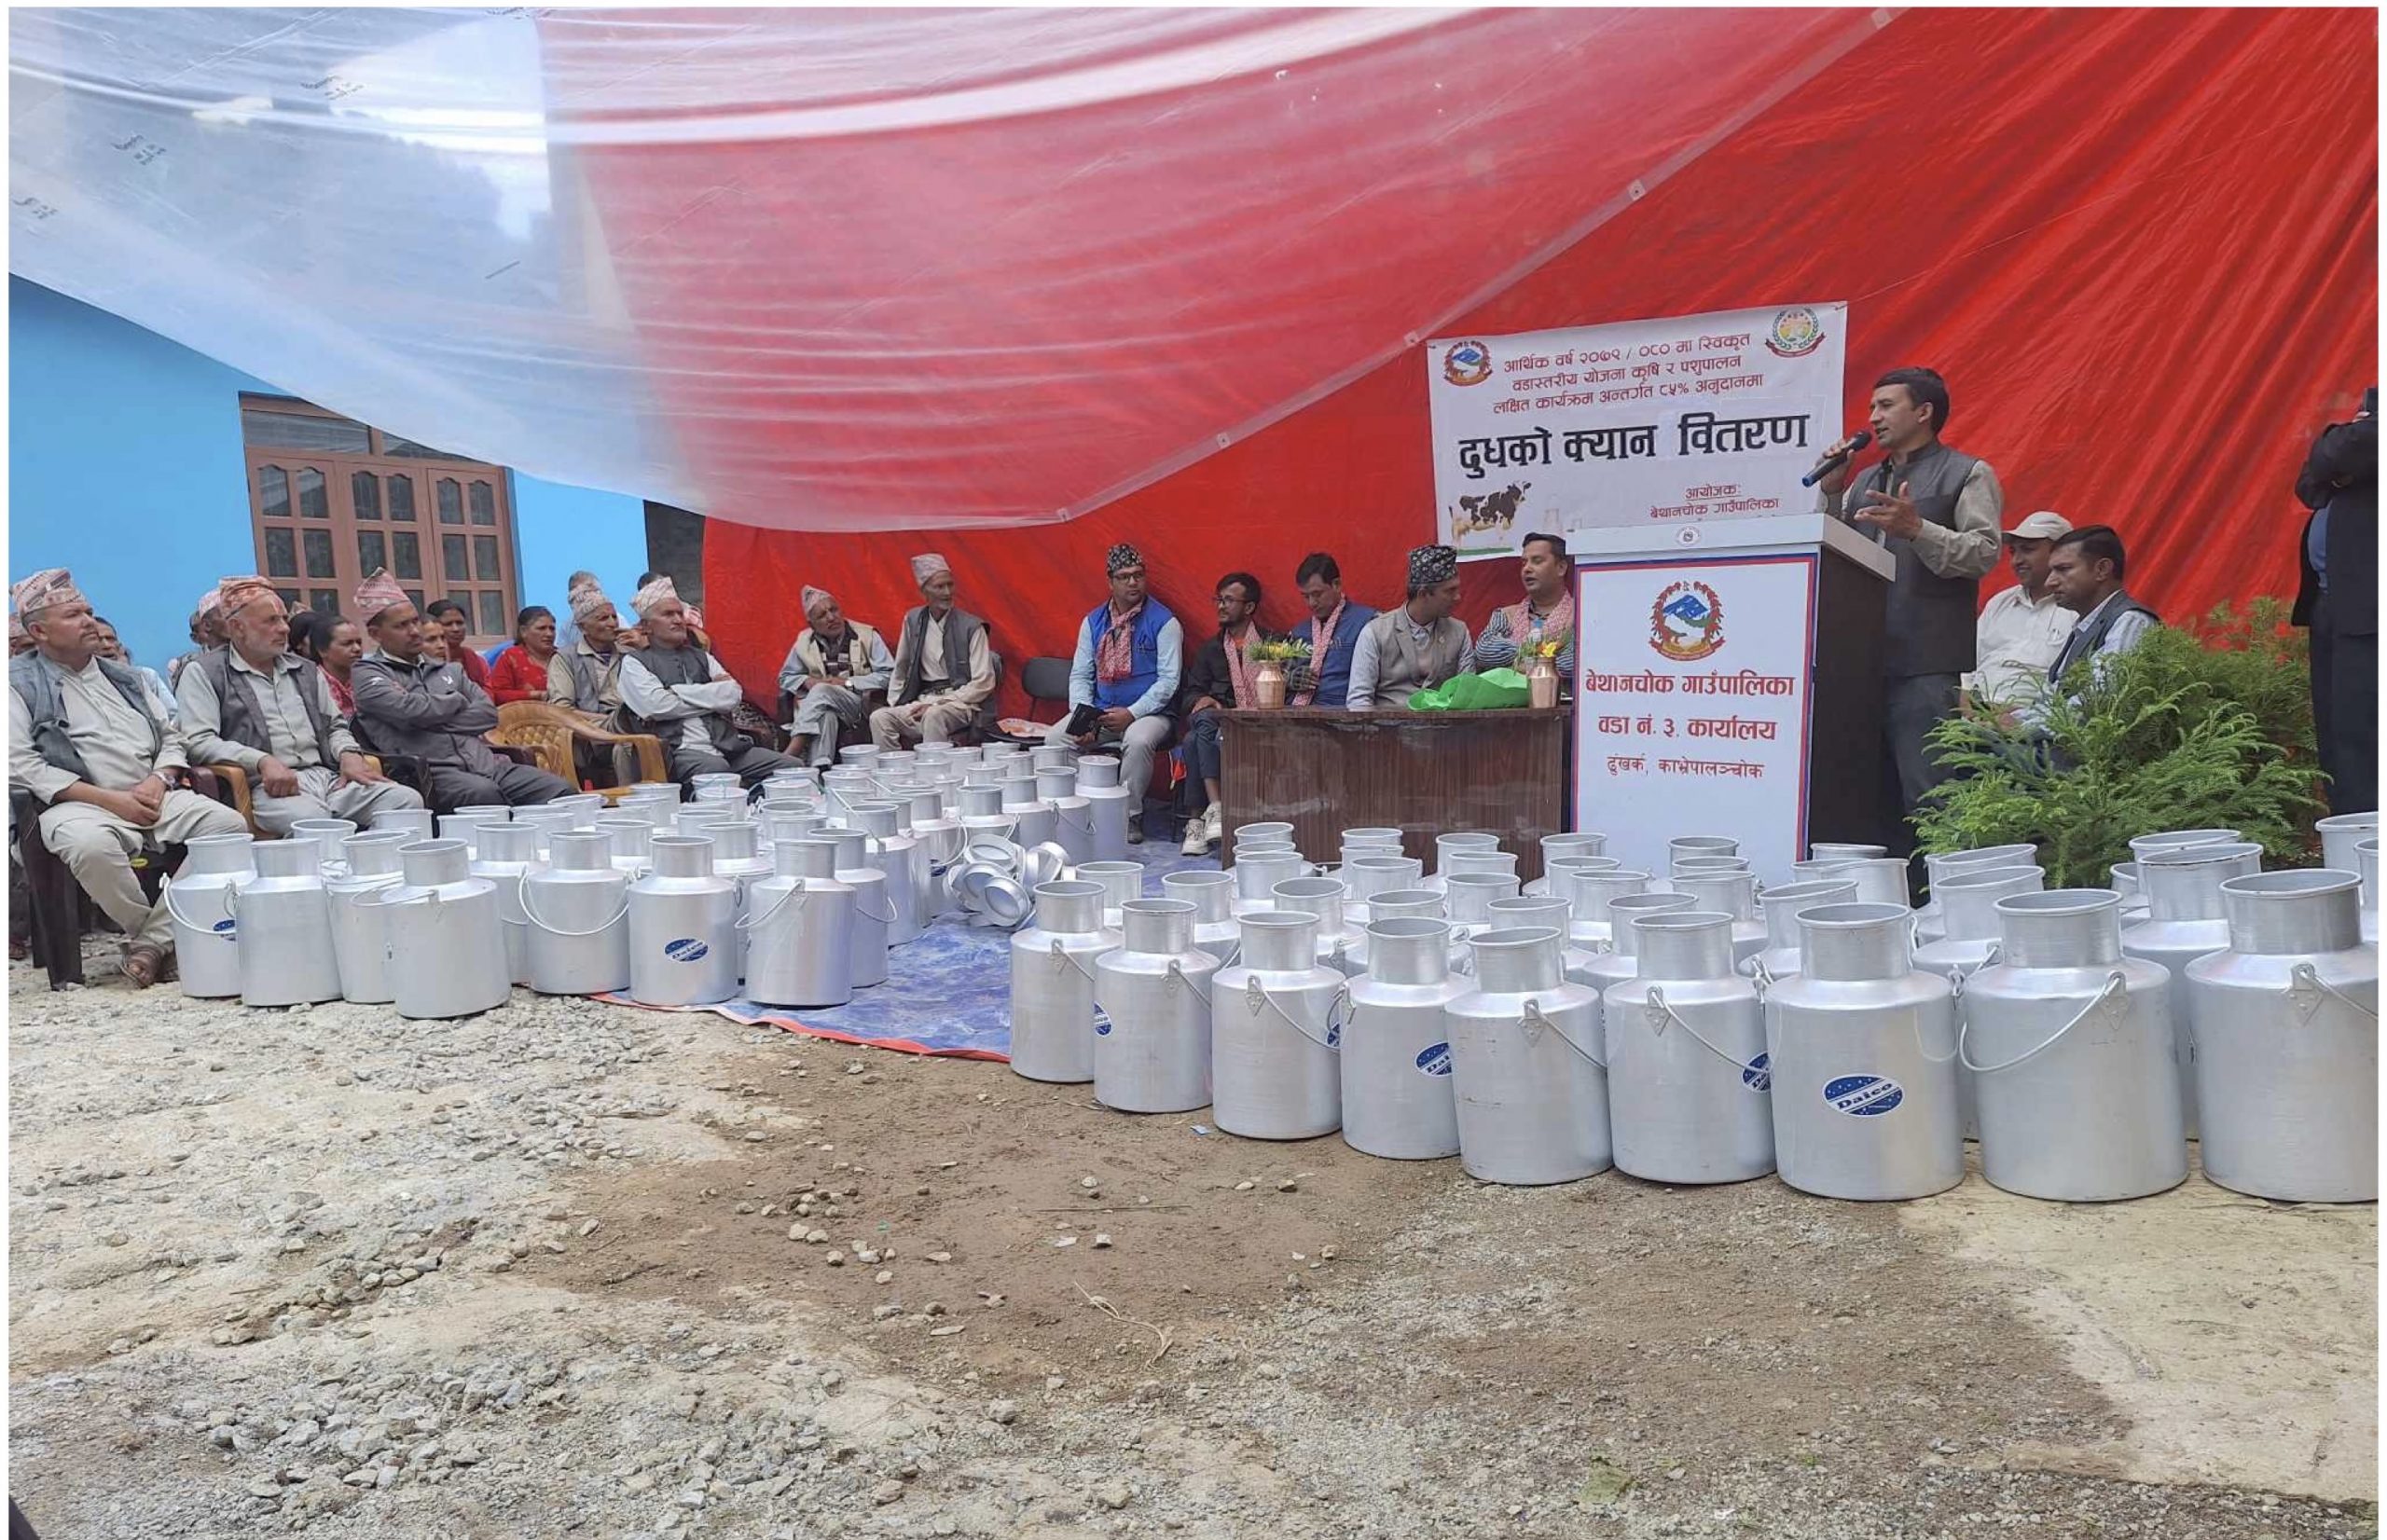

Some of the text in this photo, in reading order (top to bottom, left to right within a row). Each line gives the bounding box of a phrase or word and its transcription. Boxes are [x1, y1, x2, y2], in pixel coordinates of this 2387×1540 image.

[1504, 353, 1549, 373] आर्थिक
[1555, 349, 1573, 366] वर्ष
[1676, 339, 1692, 354] मा
[1512, 372, 1578, 392] वडास्तरीय
[1583, 366, 1625, 385] योजना
[1631, 362, 1660, 384] कृषि
[1666, 361, 1675, 375] र
[1680, 354, 1742, 376] पशुपालन
[1494, 398, 1530, 415] लक्षित
[1536, 390, 1594, 409] कार्यक्रम
[1599, 384, 1653, 404] अन्तर्गत
[1695, 373, 1763, 394] अनुदानमा
[1459, 413, 1810, 479] दुधको क्यान वितरण
[1650, 498, 1780, 519] बेथानचोक गाउँपालिका
[1585, 669, 1796, 696] बेथानचोक गाउँपालिका
[1598, 714, 1778, 741] वडा नं. ३. कार्यालय
[1659, 757, 1765, 778] काभ्रेपालञ्चोक
